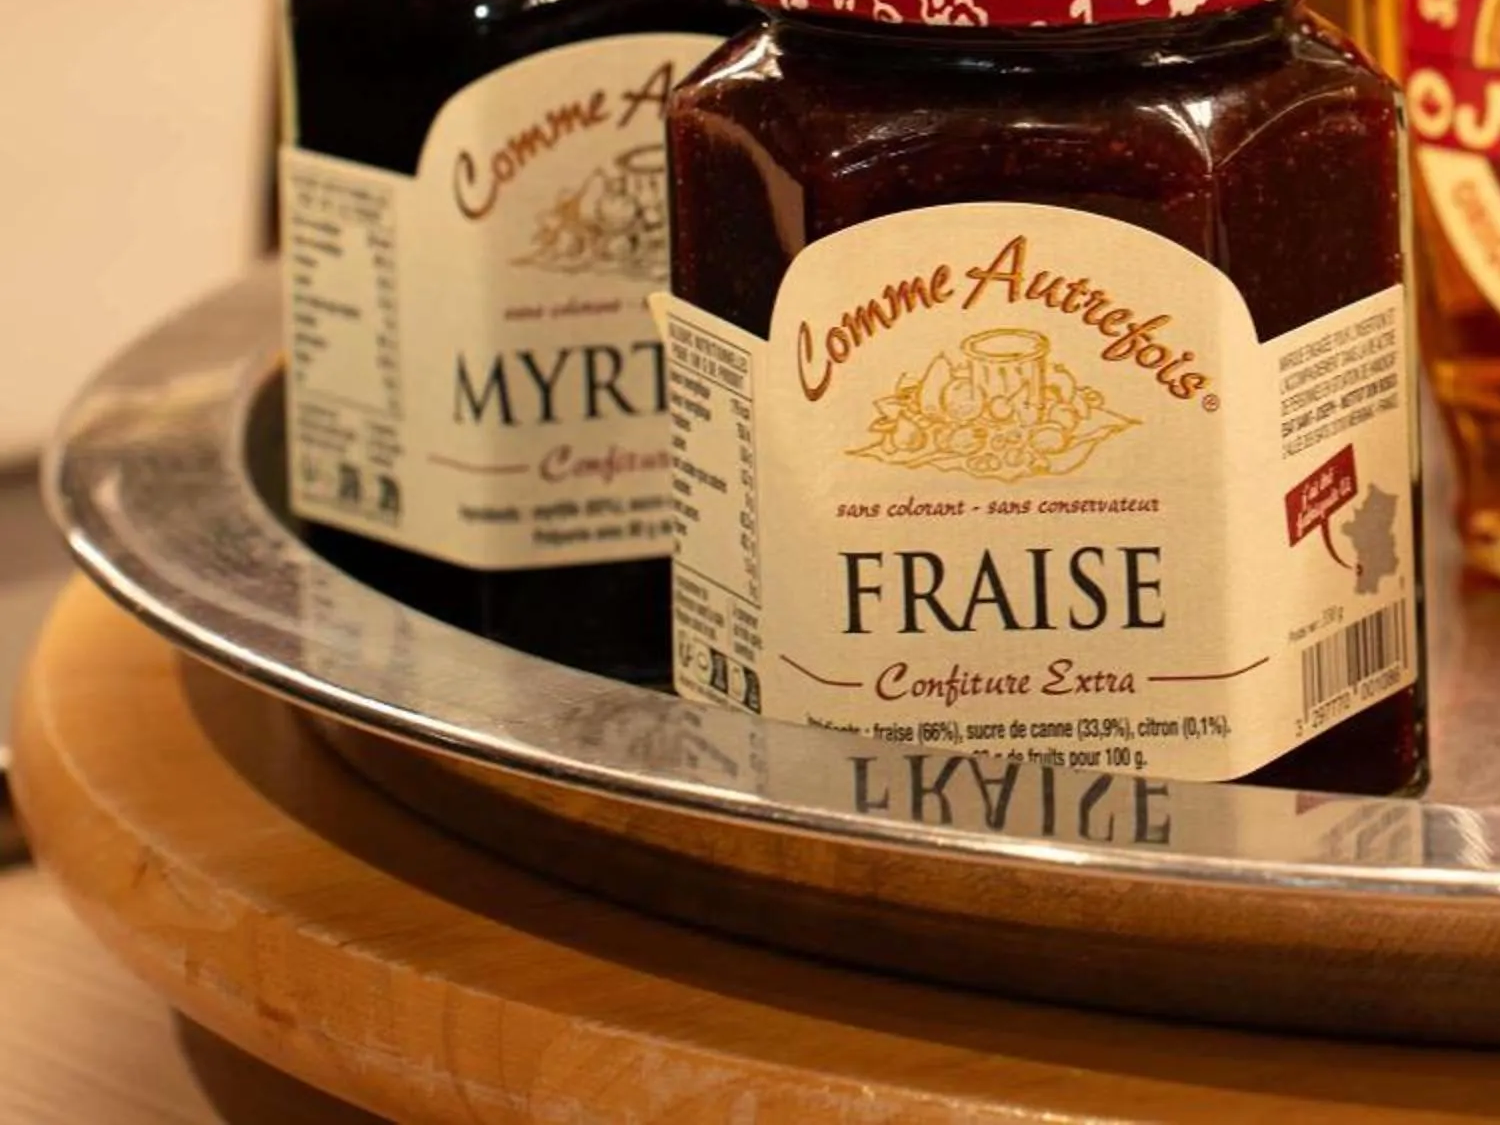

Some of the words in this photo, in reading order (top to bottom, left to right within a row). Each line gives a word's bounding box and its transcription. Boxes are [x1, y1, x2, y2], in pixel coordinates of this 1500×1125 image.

[453, 88, 612, 220] Comme
[797, 264, 953, 402] Comme
[453, 340, 669, 426] MYRT
[837, 501, 881, 517] sans
[887, 496, 964, 517] colorant
[987, 498, 1031, 515] sans
[1038, 496, 1160, 516] conservateur
[838, 546, 1166, 634] FRAISE
[875, 662, 1031, 706] Confiture
[1041, 658, 1136, 695] Extra
[873, 722, 914, 741] fraise
[966, 722, 1005, 740] sucre
[1009, 719, 1027, 738] de
[1030, 721, 1073, 739] canne
[1137, 716, 1179, 738] citron
[1068, 748, 1101, 772] pour
[1105, 746, 1131, 767] 100
